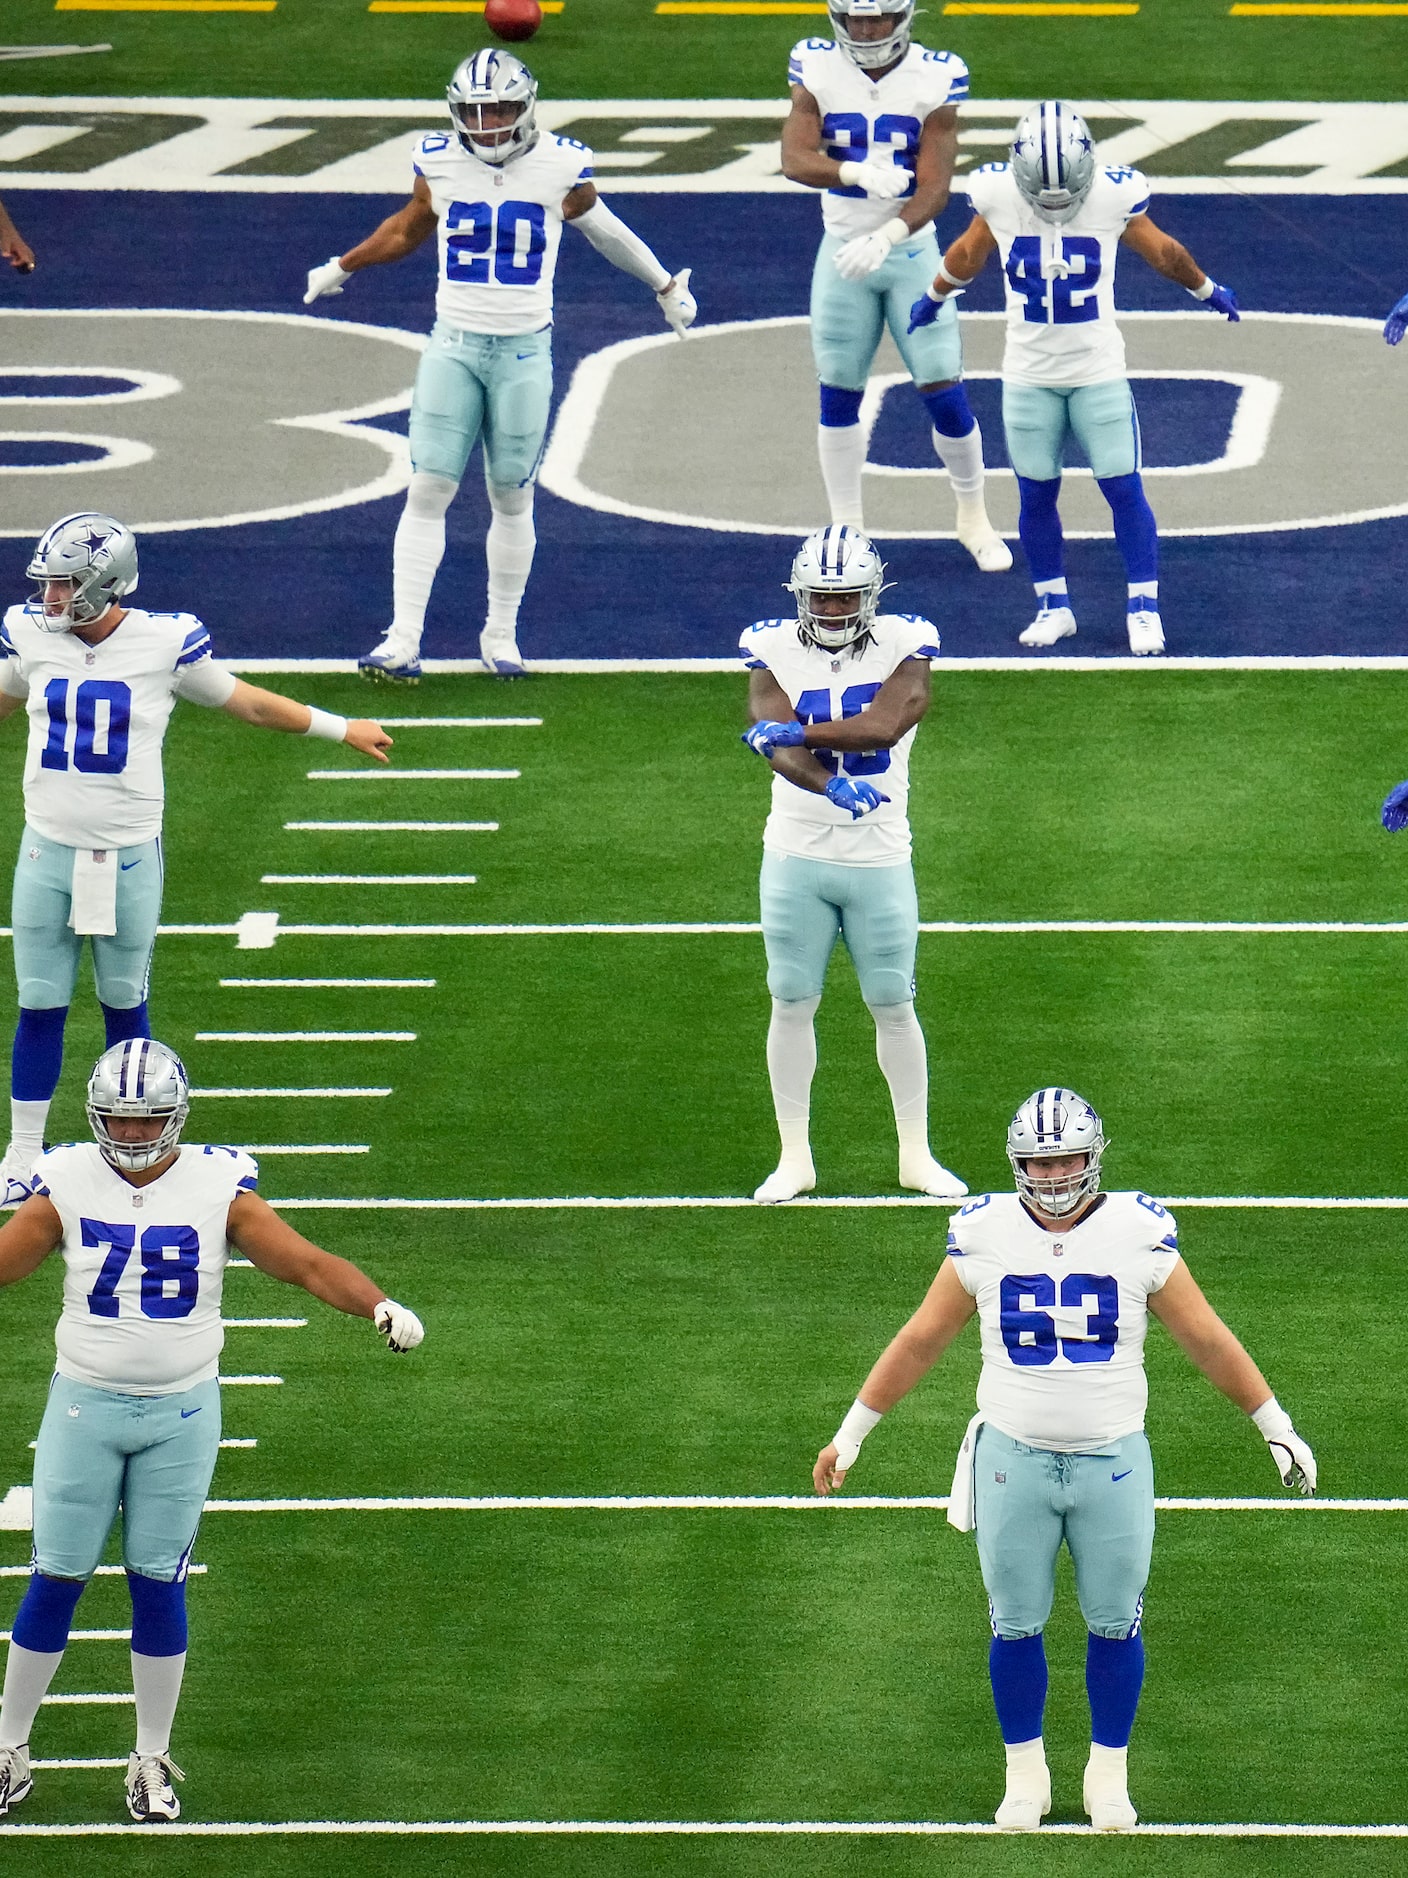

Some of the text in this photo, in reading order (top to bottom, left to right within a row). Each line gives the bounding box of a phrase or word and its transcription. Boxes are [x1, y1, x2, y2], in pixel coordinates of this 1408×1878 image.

[821, 112, 921, 198] 23
[446, 200, 547, 285] 20
[1005, 236, 1101, 324] 42
[41, 678, 132, 774] 10
[80, 1217, 200, 1318] 78
[999, 1273, 1119, 1366] 63
